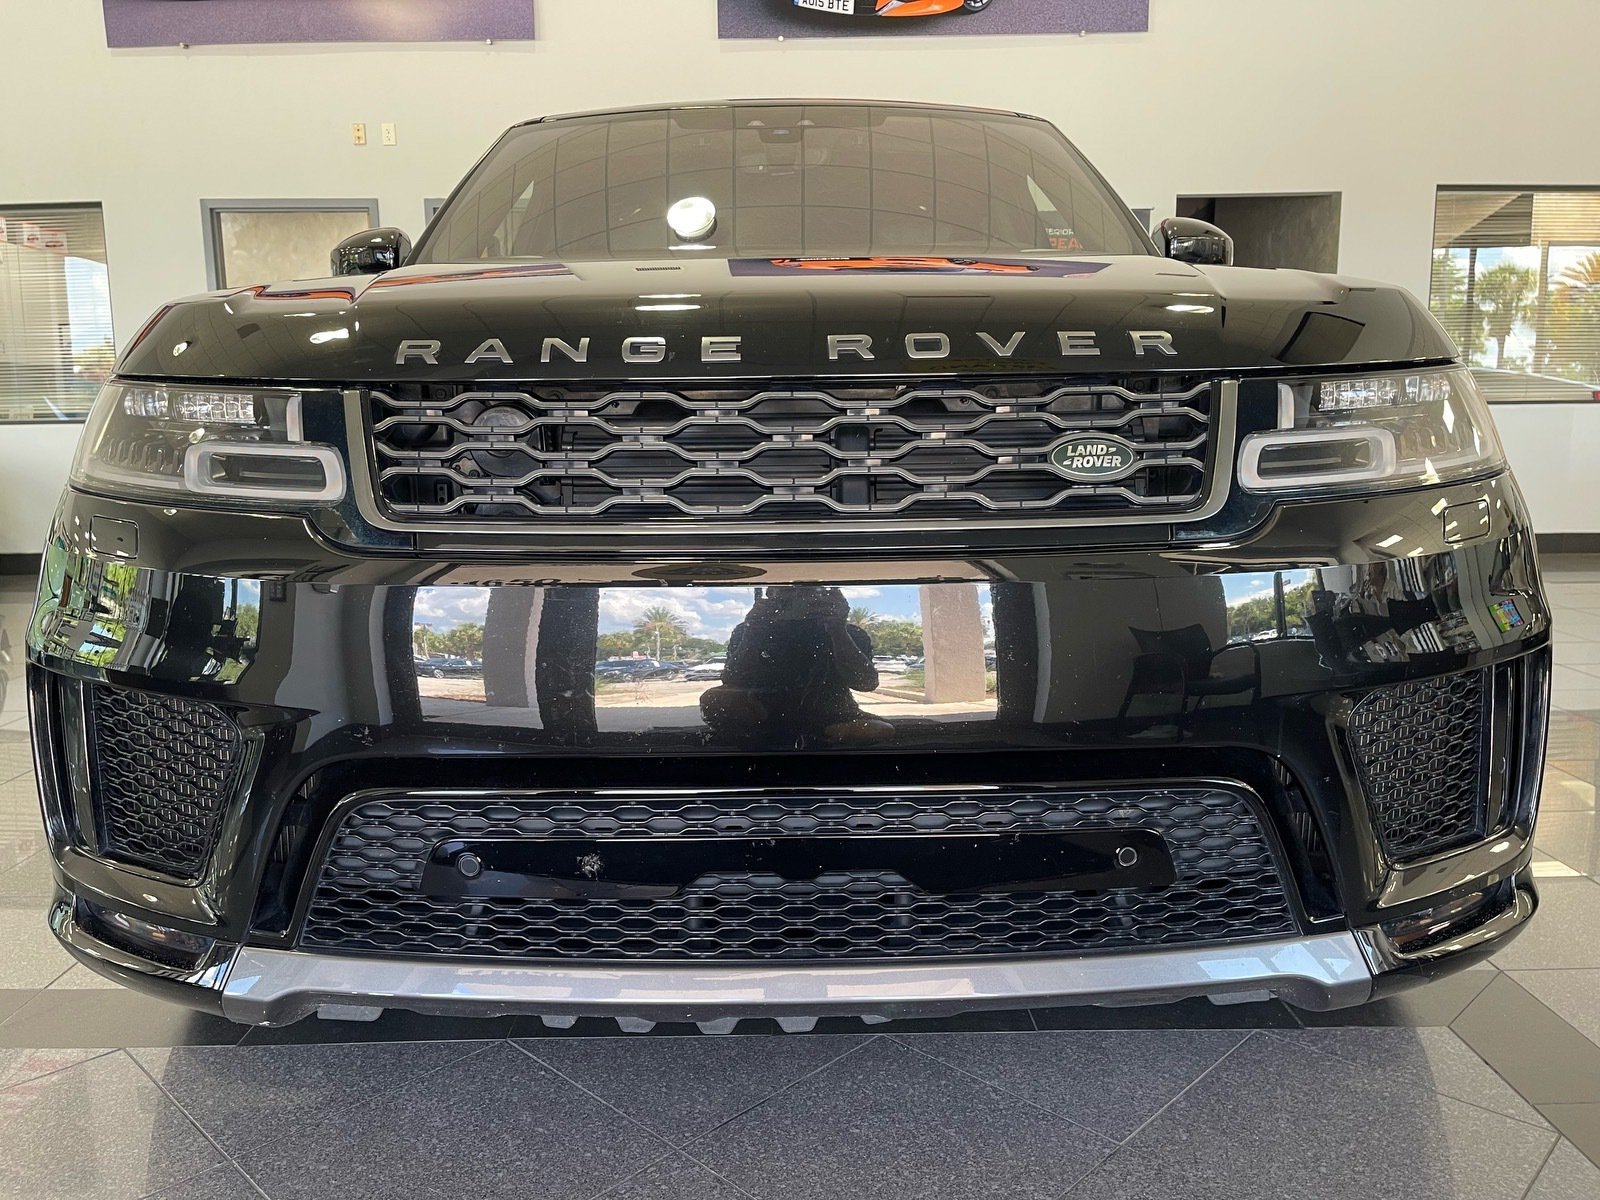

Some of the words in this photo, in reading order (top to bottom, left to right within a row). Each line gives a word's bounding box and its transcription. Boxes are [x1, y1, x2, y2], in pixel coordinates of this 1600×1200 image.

[827, 0, 850, 12] BTE
[394, 335, 742, 365] RANGE
[826, 330, 1179, 361] ROVER
[1066, 444, 1107, 457] LAND
[1072, 455, 1122, 468] ROVER
